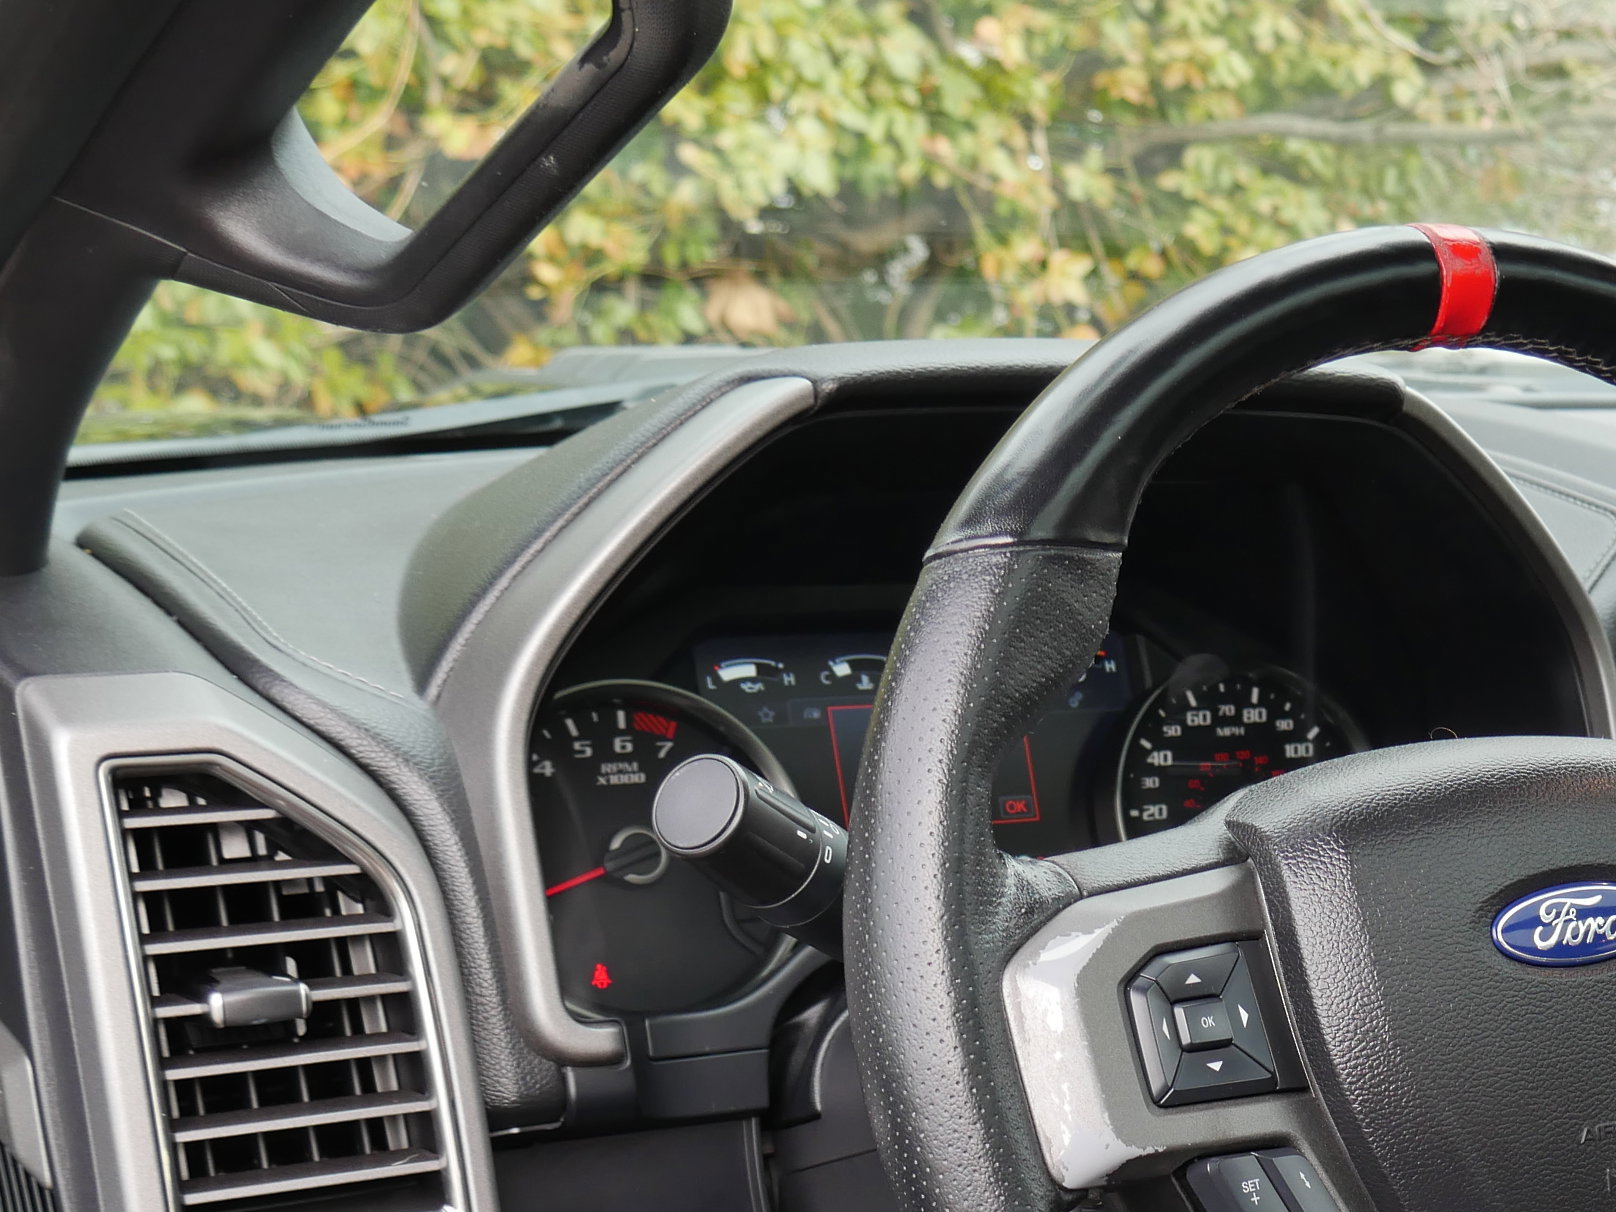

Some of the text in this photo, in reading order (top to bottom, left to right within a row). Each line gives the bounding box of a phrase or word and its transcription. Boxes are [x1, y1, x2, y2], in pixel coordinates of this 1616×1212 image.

[707, 676, 717, 689] L
[783, 672, 795, 686] H
[820, 671, 832, 685] C
[1217, 704, 1235, 716] 70
[1242, 707, 1267, 723] 80
[1186, 710, 1211, 726] 60
[1275, 719, 1294, 731] 90
[1162, 725, 1182, 737] 50
[1216, 726, 1245, 737] MPH
[572, 740, 593, 758] 5
[613, 736, 633, 753] 6
[655, 741, 674, 759] 7
[1284, 742, 1314, 758] 100
[1146, 750, 1173, 766] 40
[532, 760, 555, 777] 4
[601, 761, 639, 774] RPM
[1141, 777, 1160, 789] 30
[1005, 800, 1027, 814] OK
[1142, 804, 1168, 821] 20
[1201, 1016, 1215, 1029] OK
[1242, 1179, 1260, 1193] SET
